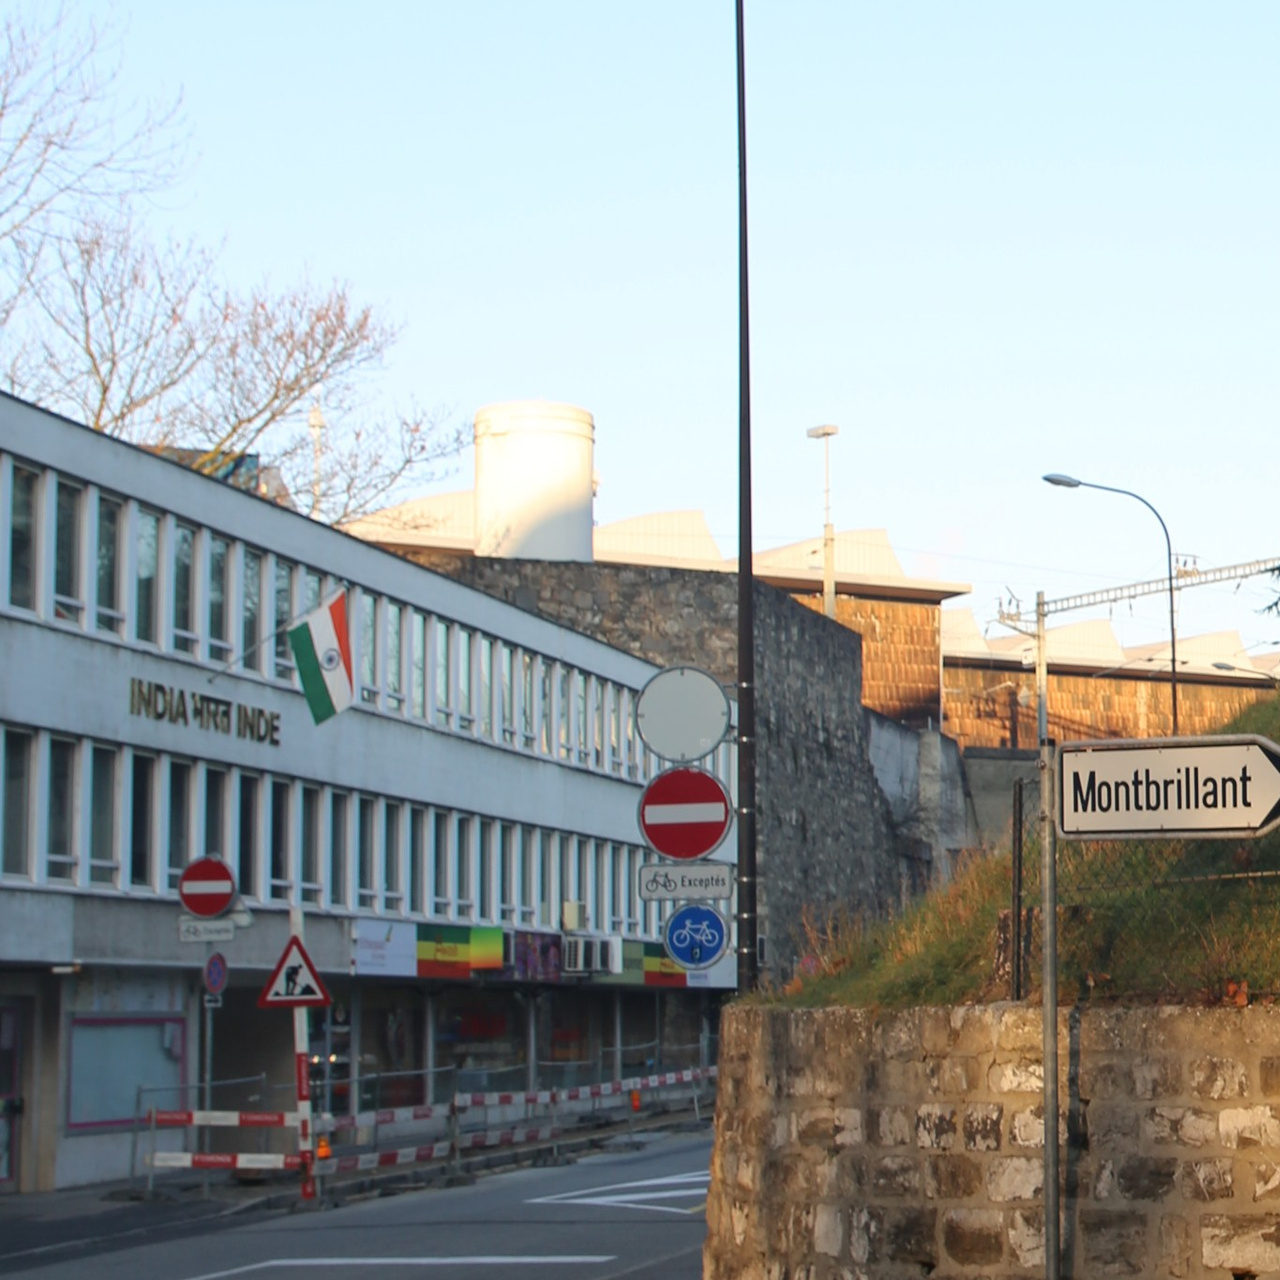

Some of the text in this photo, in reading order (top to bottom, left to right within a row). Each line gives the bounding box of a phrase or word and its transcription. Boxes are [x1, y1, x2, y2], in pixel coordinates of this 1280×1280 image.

[130, 677, 281, 746] INDIA भारत INDE
[1072, 764, 1252, 813] Montbrillant
[681, 875, 726, 890] Exceptés
